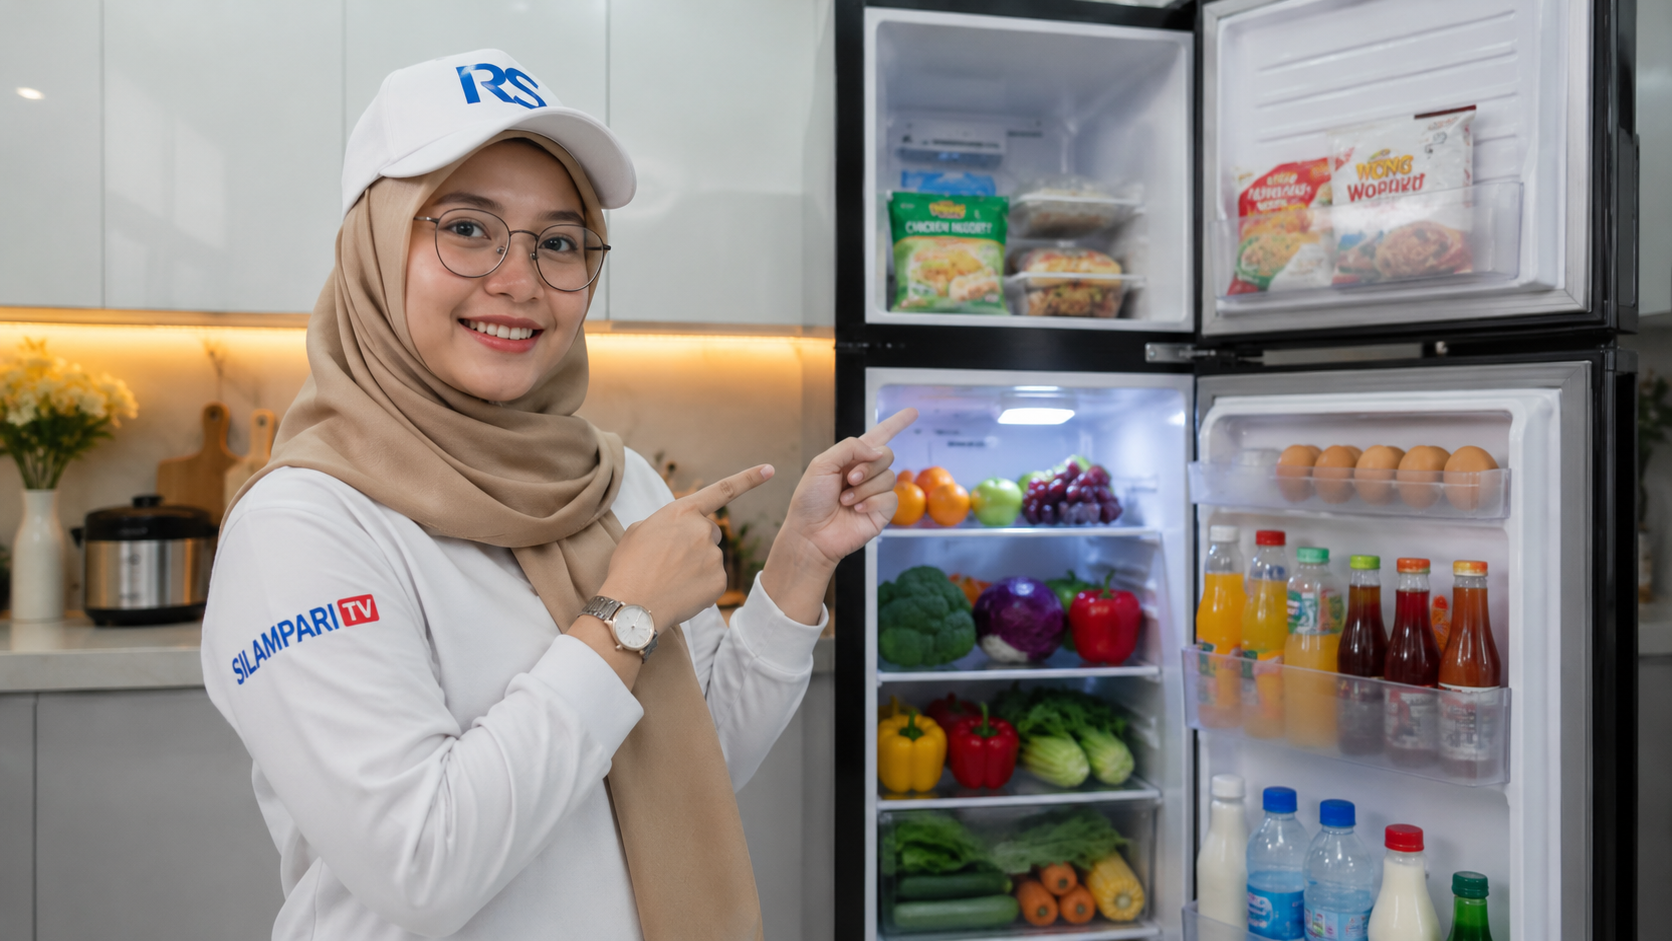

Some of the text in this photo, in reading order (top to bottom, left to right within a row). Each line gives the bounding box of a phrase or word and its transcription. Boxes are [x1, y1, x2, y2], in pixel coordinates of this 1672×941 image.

[455, 63, 547, 110] RS
[232, 599, 372, 685] SILAMPARI TV
